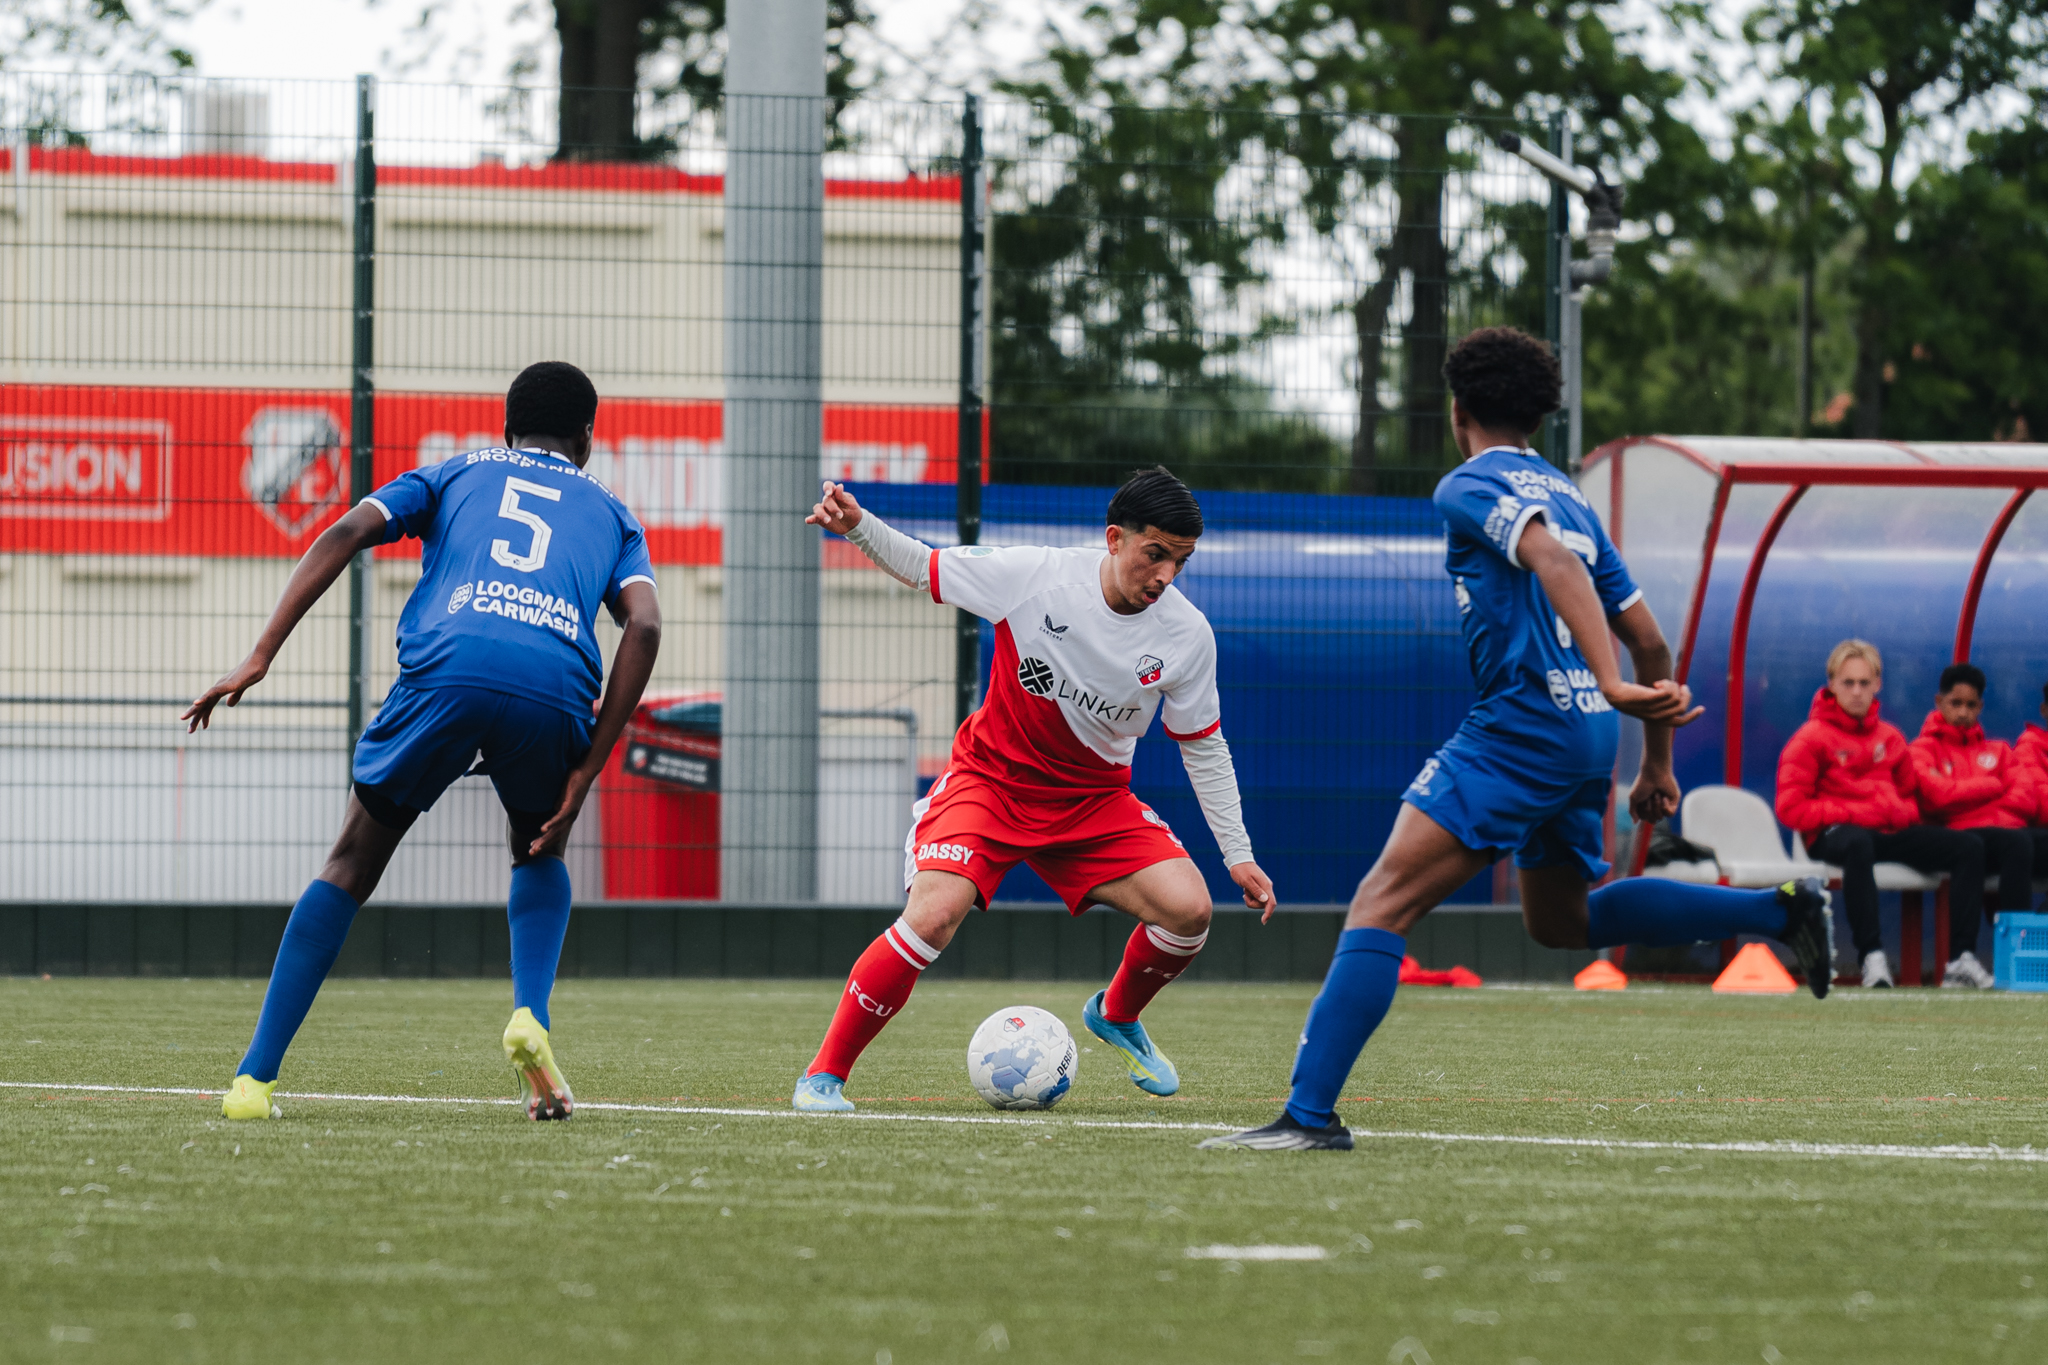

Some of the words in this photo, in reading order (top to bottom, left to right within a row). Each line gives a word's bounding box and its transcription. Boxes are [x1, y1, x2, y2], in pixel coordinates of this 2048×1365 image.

[490, 475, 562, 573] 5
[472, 596, 578, 641] CARWASH
[475, 580, 579, 624] LOOGMAN
[1058, 679, 1141, 721] LINKIT
[917, 842, 974, 866] DASSY
[848, 979, 893, 1017] FCU
